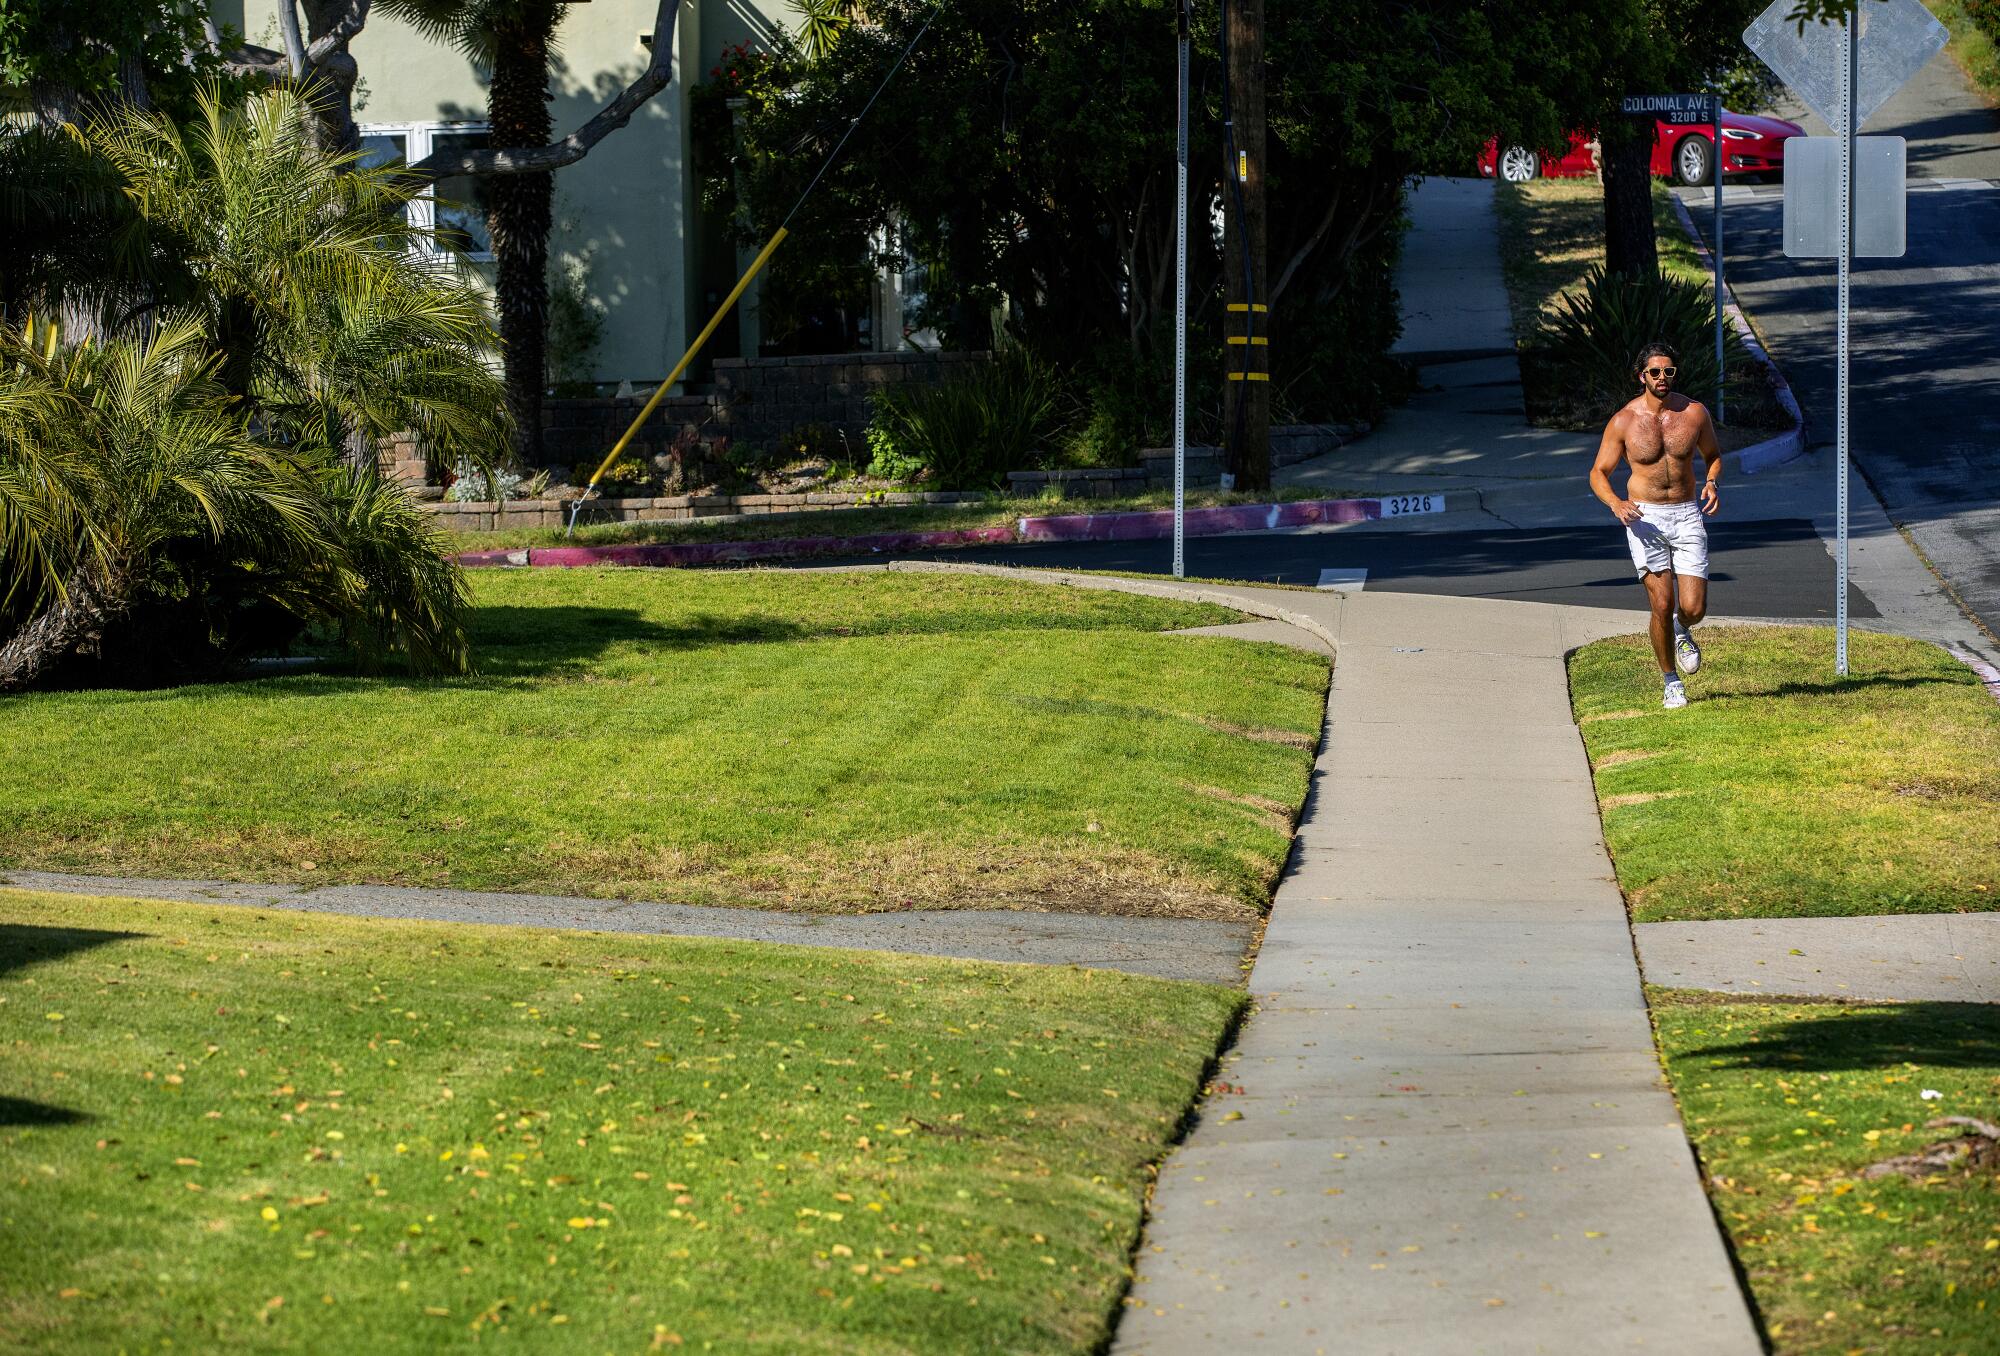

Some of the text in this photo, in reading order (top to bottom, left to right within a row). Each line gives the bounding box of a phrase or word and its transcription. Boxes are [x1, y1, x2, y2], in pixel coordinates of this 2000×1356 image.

[1623, 97, 1683, 111] COLONIAL
[1670, 111, 1697, 123] 3200
[1391, 496, 1431, 515] 3226
